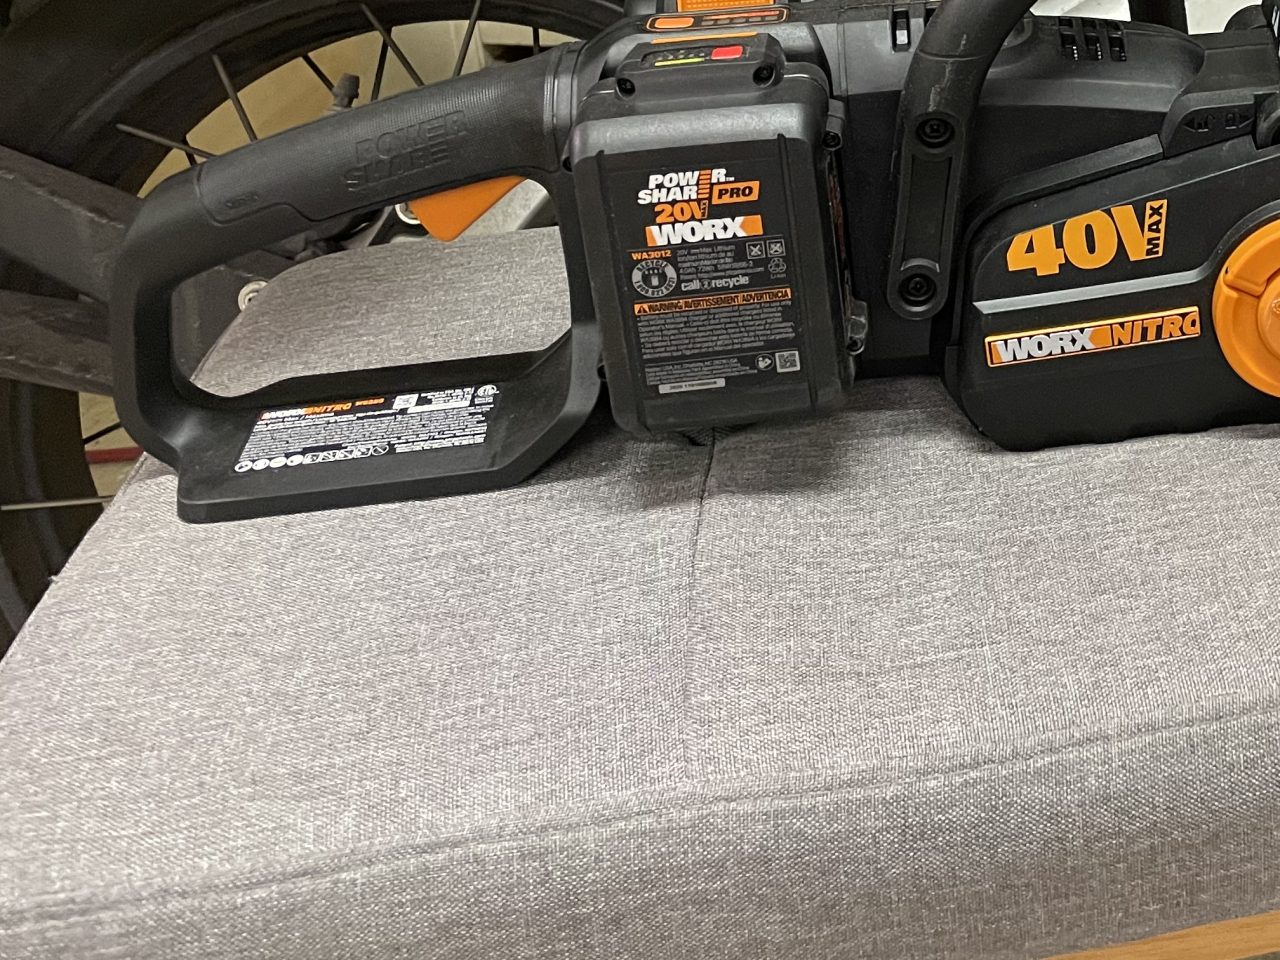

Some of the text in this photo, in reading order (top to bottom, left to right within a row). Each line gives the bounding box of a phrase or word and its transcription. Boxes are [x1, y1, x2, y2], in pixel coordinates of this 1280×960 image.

[649, 168, 727, 189] POWER
[637, 184, 754, 205] SHARE PRO
[654, 201, 703, 224] 20V
[650, 216, 748, 246] WORX
[1006, 202, 1164, 276] 40V MAX
[631, 249, 672, 261] WA3012
[996, 313, 1200, 363] WORX NITRO
